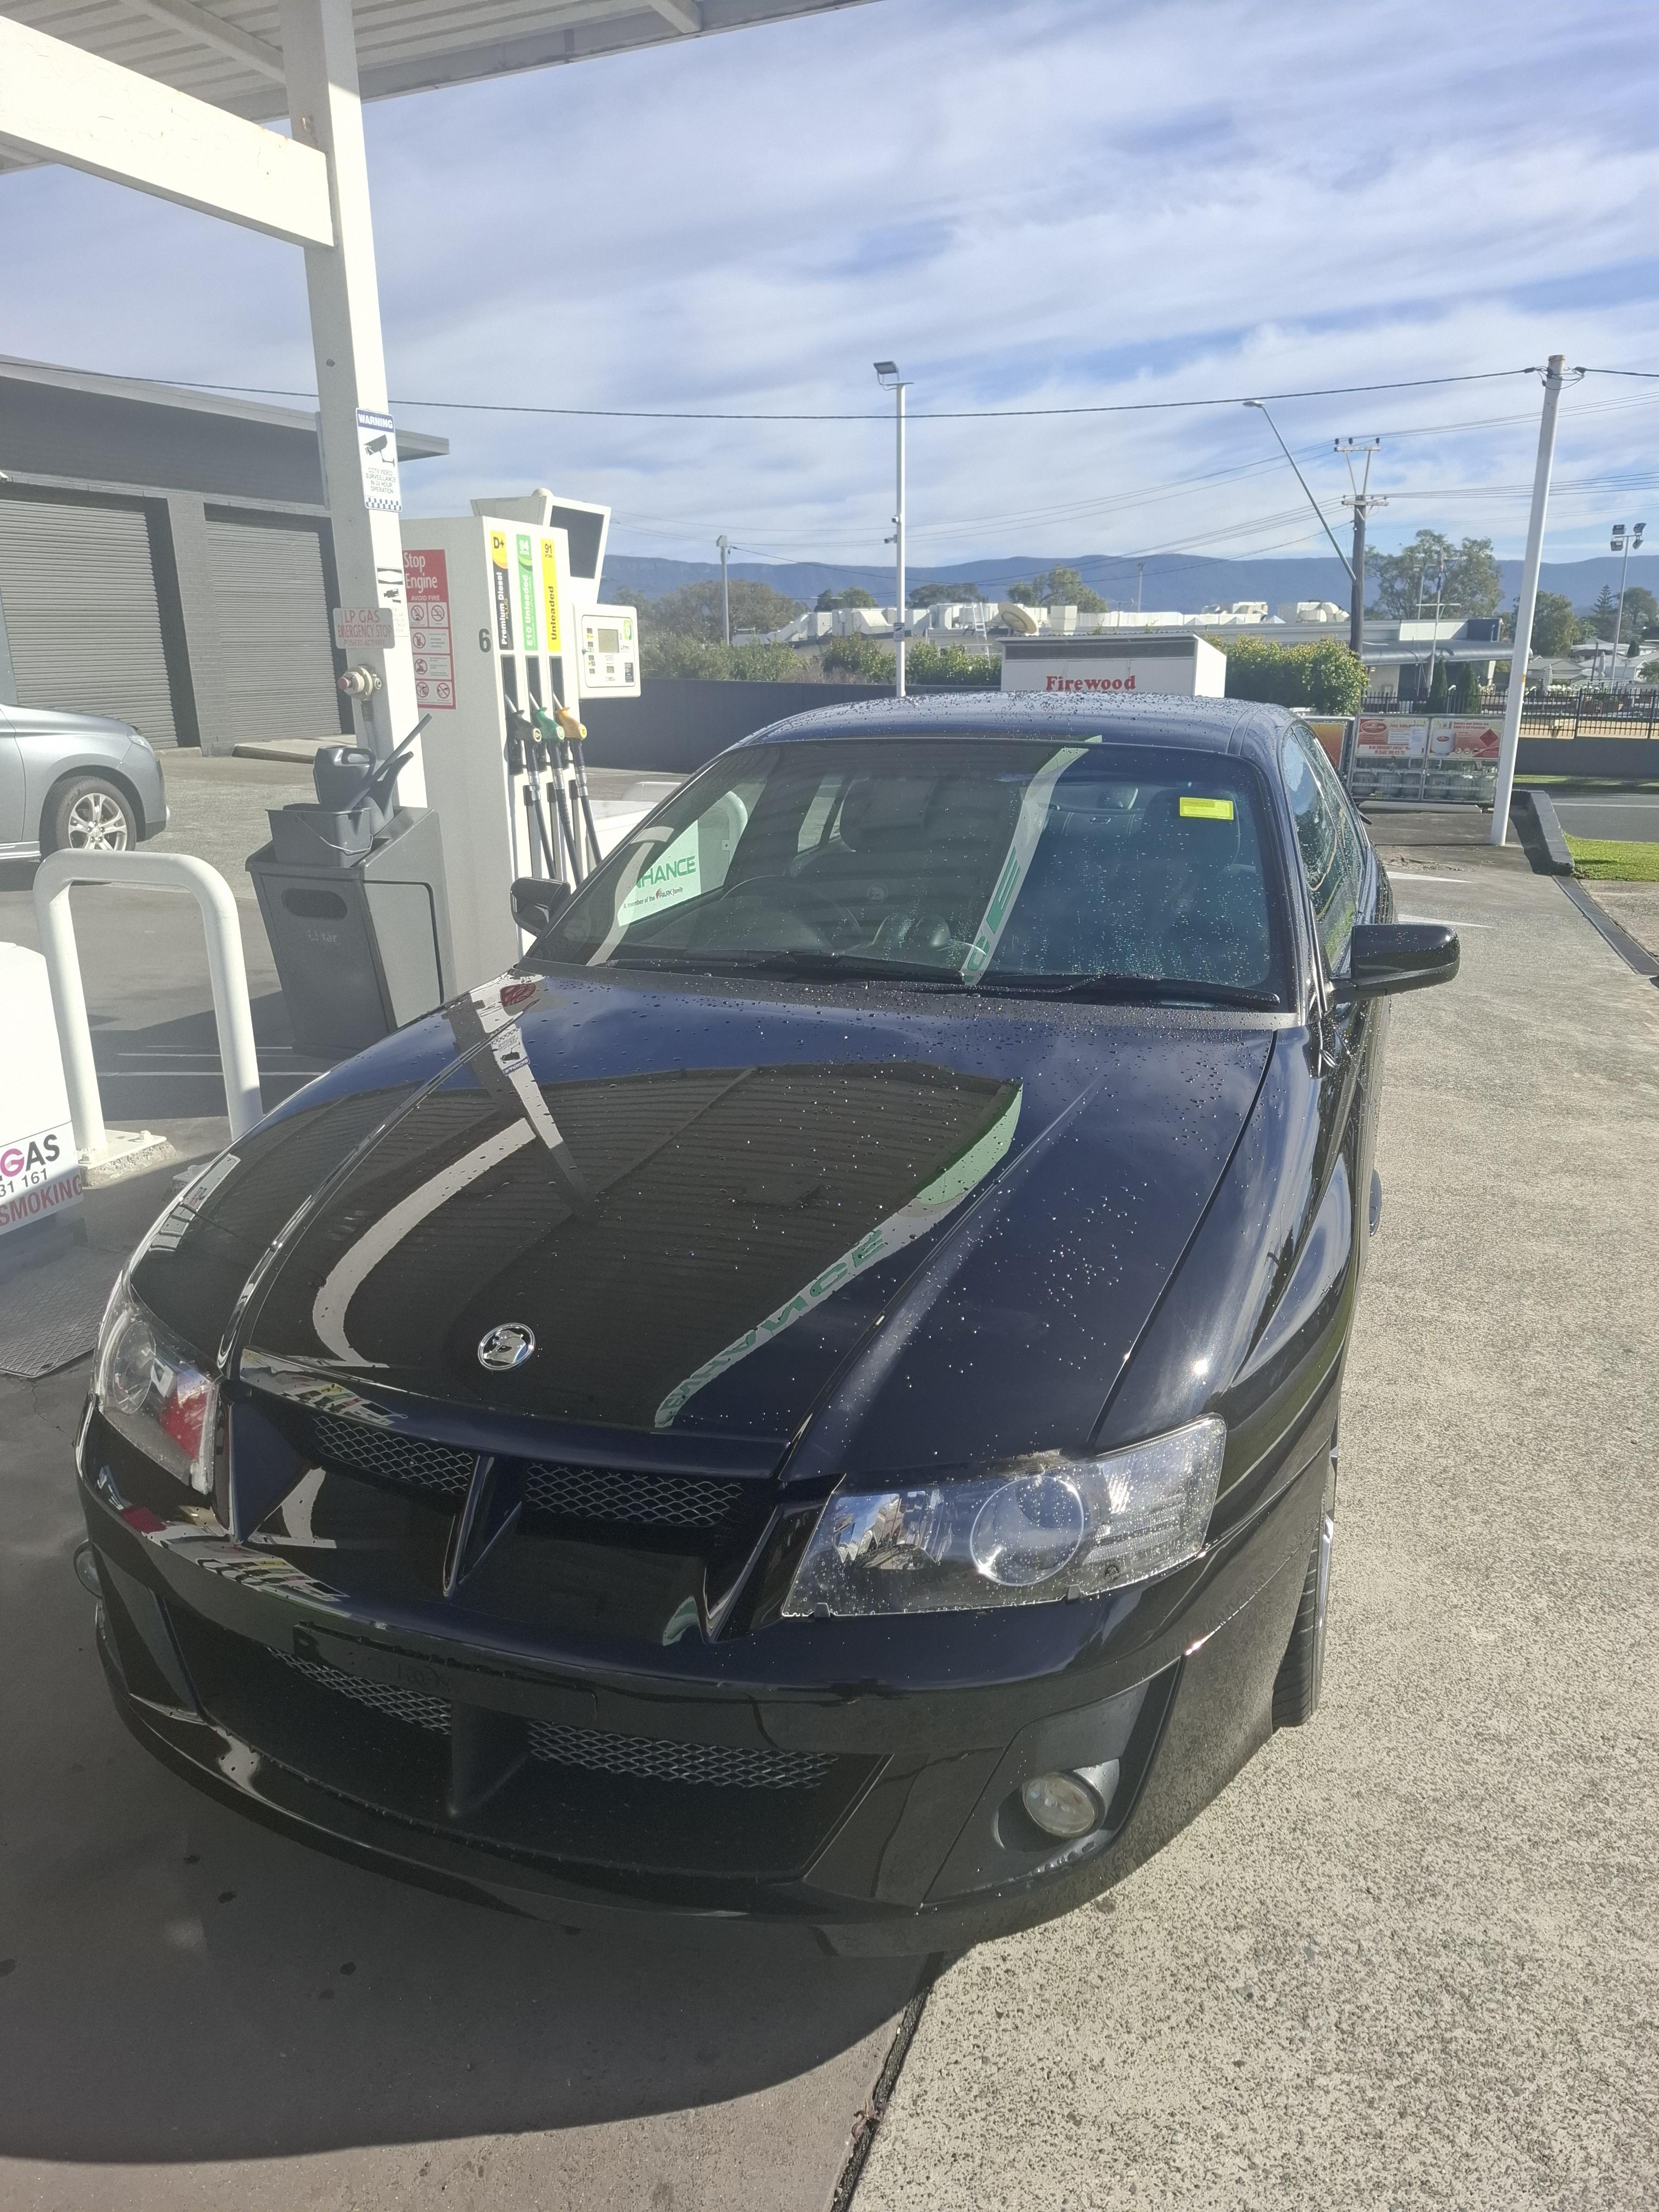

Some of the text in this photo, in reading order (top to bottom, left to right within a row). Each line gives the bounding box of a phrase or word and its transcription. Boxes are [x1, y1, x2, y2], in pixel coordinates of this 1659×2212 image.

[358, 414, 393, 429] WARNING
[365, 473, 396, 483] SURVEILLANCE
[493, 536, 505, 549] D+
[544, 543, 552, 554] 91
[404, 552, 426, 573] Stop
[405, 572, 438, 594] Engine
[496, 572, 507, 645] Premium Diesel
[522, 574, 531, 623] Unleaded
[345, 610, 356, 623] LP
[358, 609, 380, 623] GAS
[548, 586, 557, 640] Unleaded
[338, 624, 393, 638] EMERGENCY STOP
[479, 628, 492, 653] 6
[525, 626, 533, 646] E10
[1046, 675, 1136, 692] Firewood
[627, 898, 644, 908] member
[658, 889, 673, 899] PARK
[0, 1134, 60, 1181] GAS
[21, 1168, 48, 1188] 161
[0, 1174, 82, 1226] SMOKING
